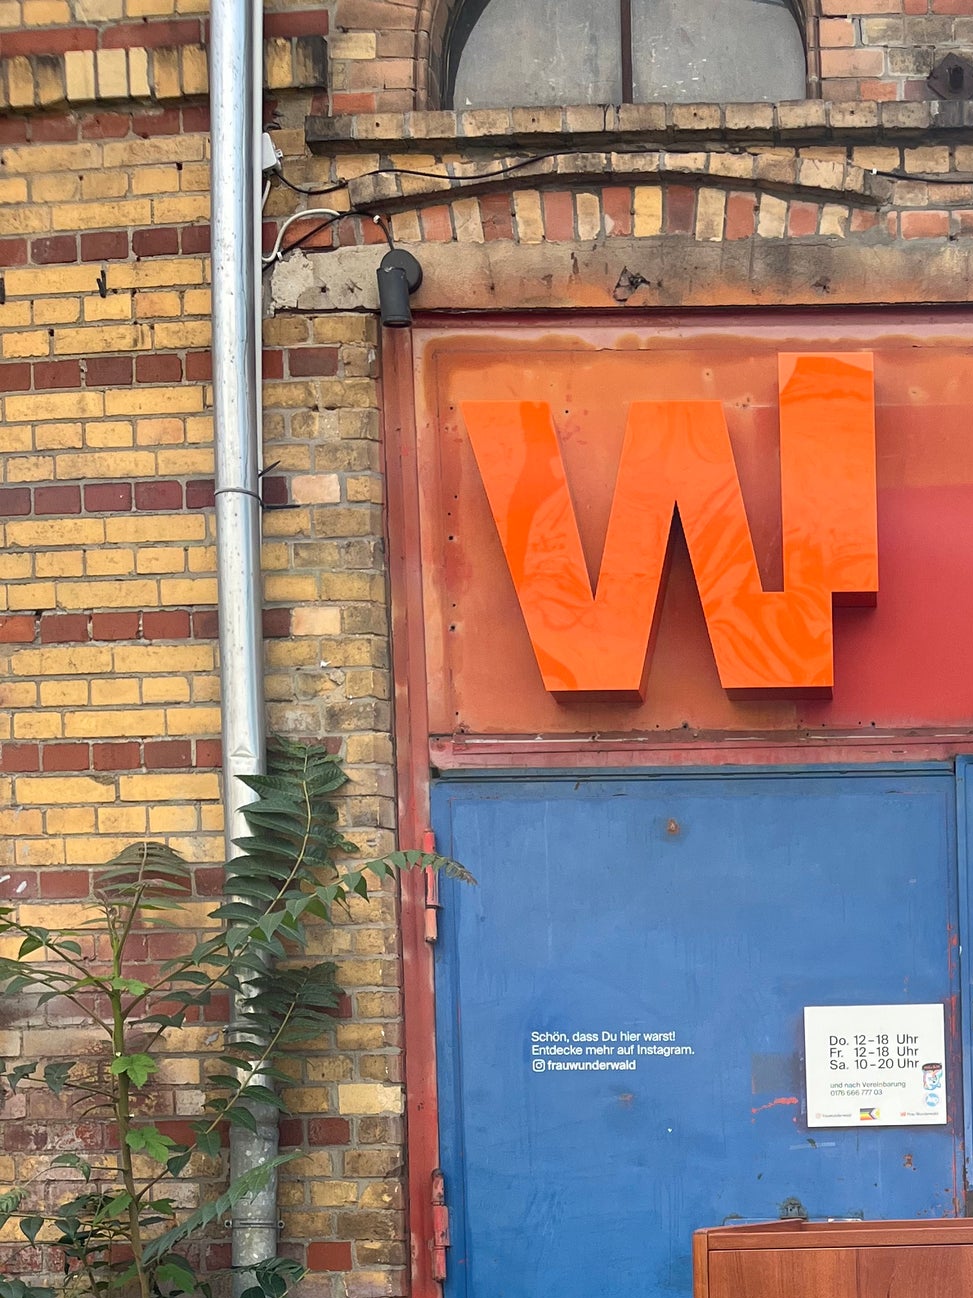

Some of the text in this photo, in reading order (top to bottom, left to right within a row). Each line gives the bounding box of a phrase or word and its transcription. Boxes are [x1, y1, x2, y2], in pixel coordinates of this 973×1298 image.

[531, 1031, 676, 1043] Schön, dass Du hier warst!
[829, 1035, 849, 1046] Do.
[896, 1033, 919, 1045] Uhr
[531, 1045, 695, 1057] Entdecke mehr auf Instagram.
[829, 1047, 844, 1058] Fr.
[897, 1046, 919, 1057] Uhr
[547, 1060, 636, 1071] frauwunderwald
[829, 1059, 849, 1070] Sa.
[897, 1058, 920, 1069] Uhr
[830, 1081, 843, 1089] und
[862, 1081, 907, 1089] Vereinbarung
